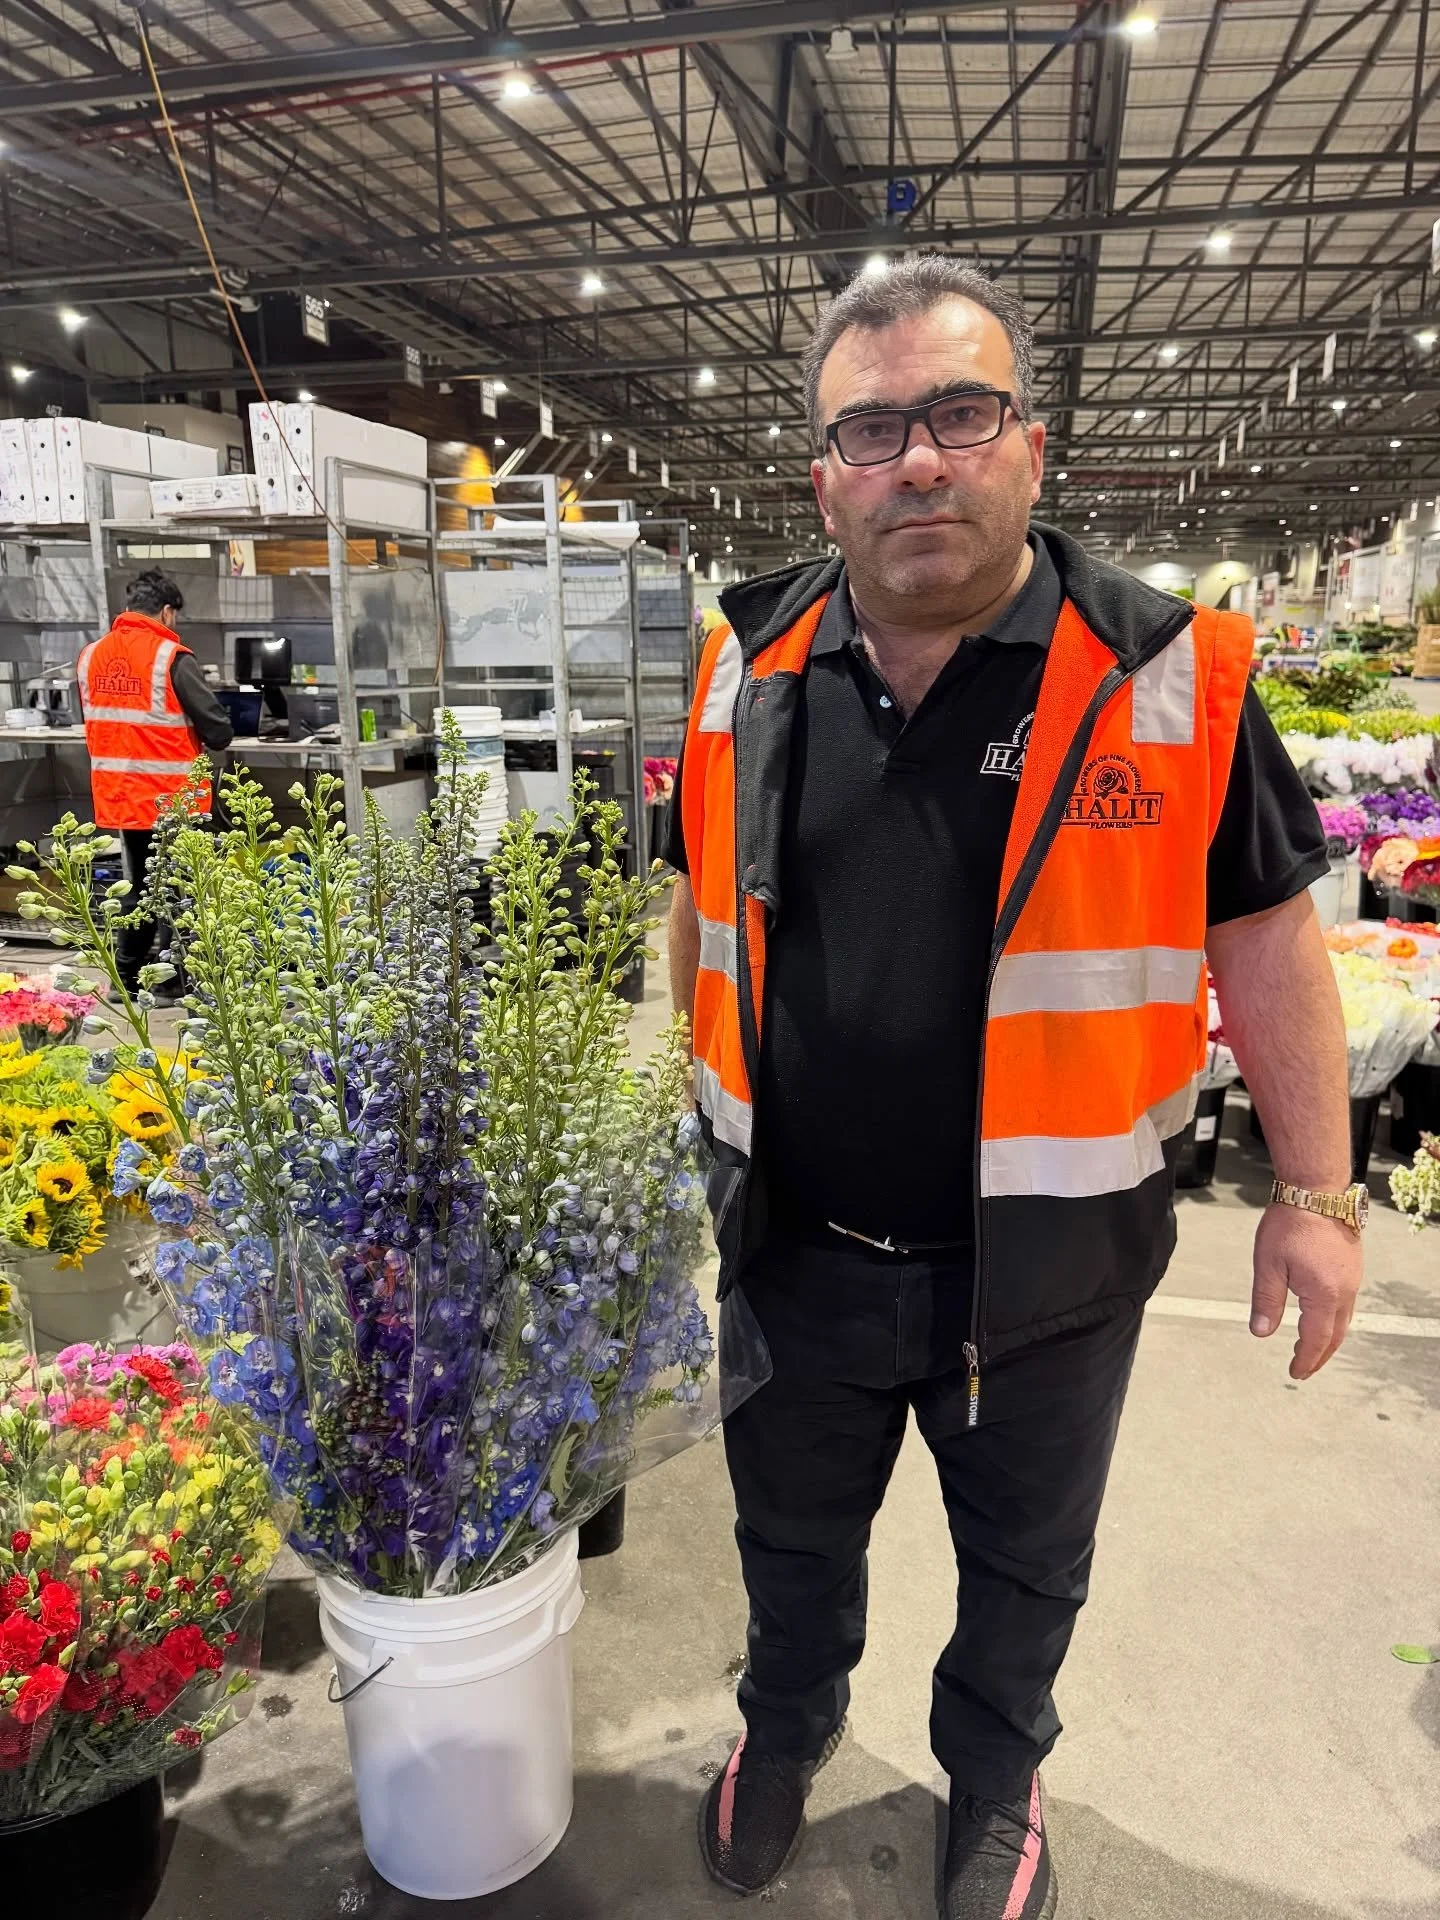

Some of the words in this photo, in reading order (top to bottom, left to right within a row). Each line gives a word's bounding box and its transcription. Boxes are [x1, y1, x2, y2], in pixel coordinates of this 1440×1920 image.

[97, 678, 138, 691] HALIT
[1080, 759, 1098, 793] GROWERS
[1097, 754, 1109, 763] OF
[1109, 753, 1126, 764] FINE
[1126, 760, 1142, 793] FLOWERS
[1064, 798, 1158, 819] HALIT
[968, 1376, 978, 1426] FIRESTORM
